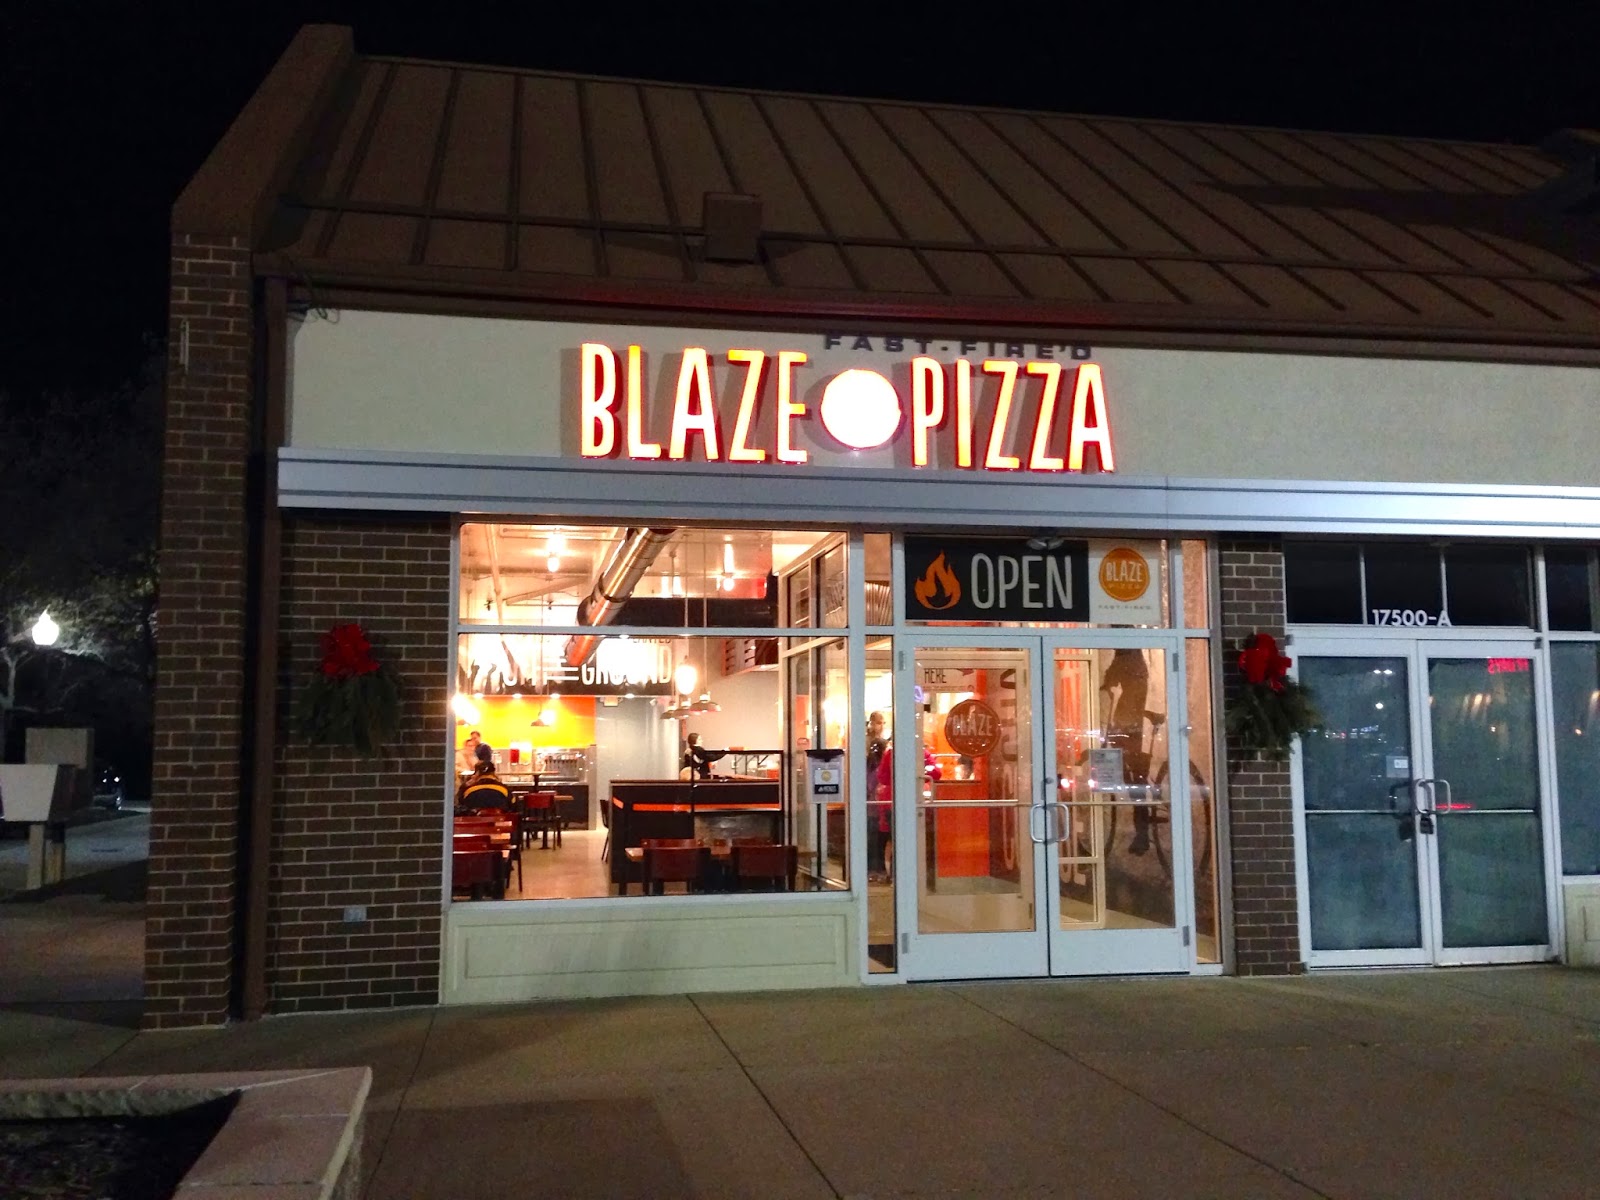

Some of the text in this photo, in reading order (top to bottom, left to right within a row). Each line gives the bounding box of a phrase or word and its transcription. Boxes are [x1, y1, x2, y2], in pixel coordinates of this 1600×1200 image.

[580, 342, 1115, 473] BLAZE PIZZA
[971, 553, 1073, 609] OPEN
[1105, 560, 1143, 582] BLAZE
[1371, 608, 1452, 627] 17500-A
[952, 713, 993, 736] BLAZE
